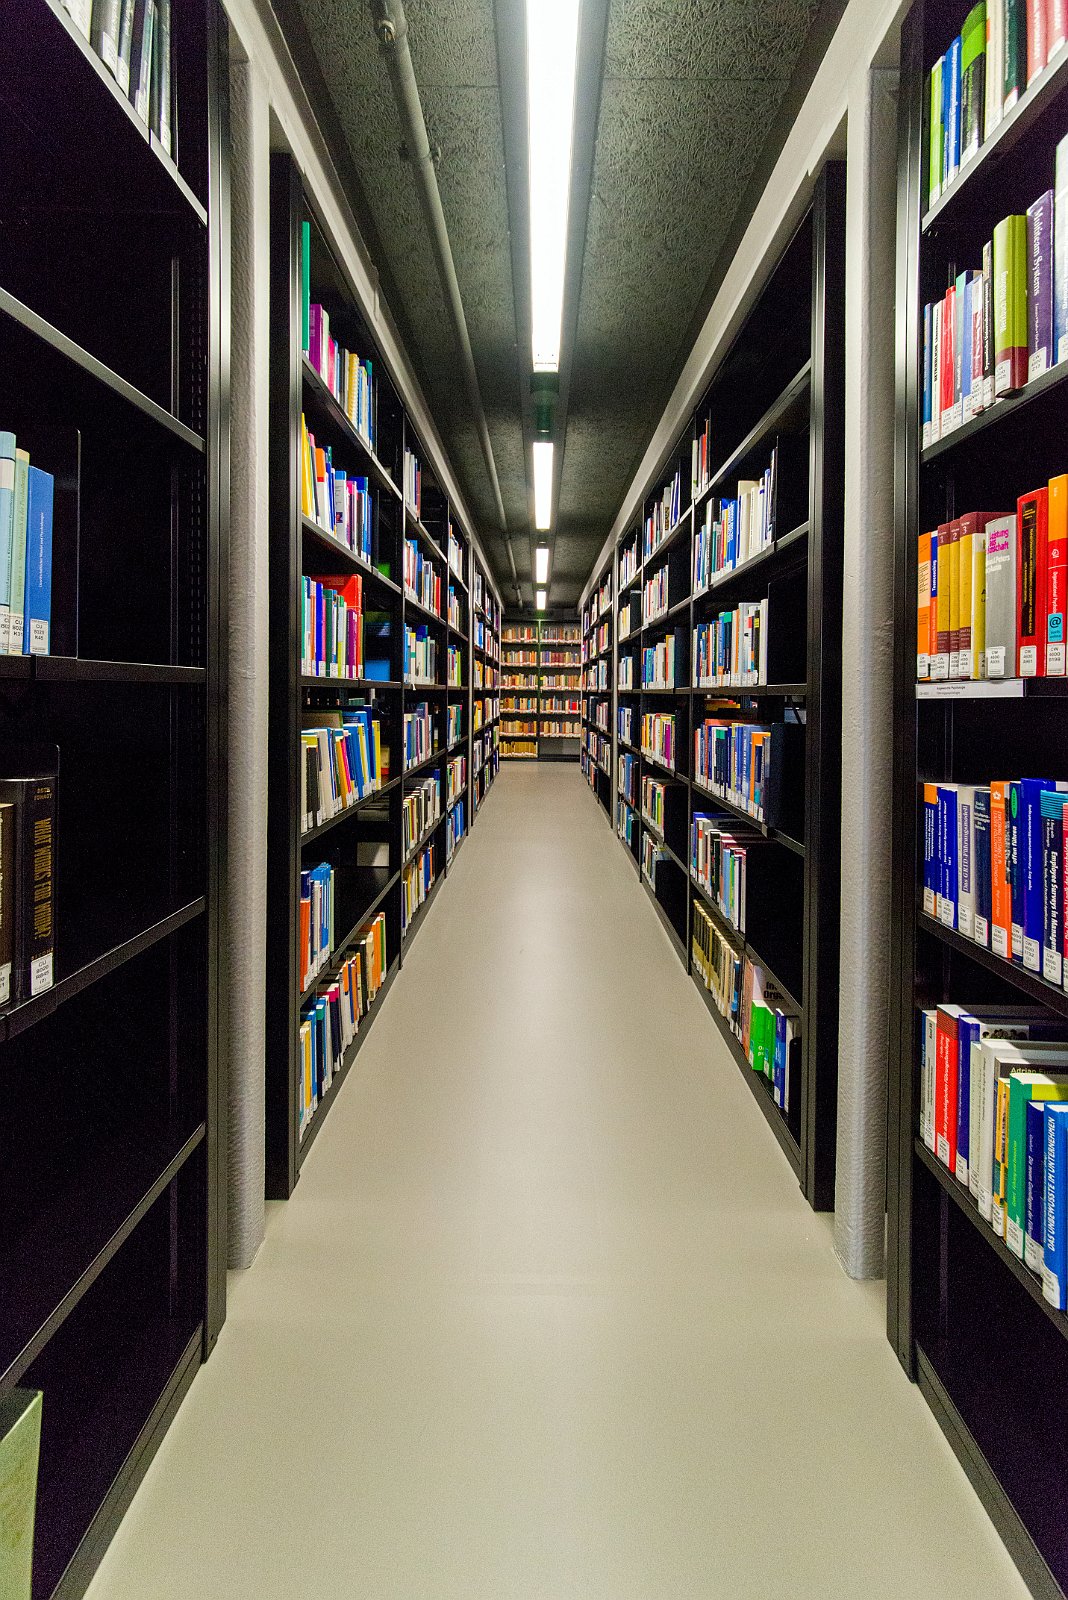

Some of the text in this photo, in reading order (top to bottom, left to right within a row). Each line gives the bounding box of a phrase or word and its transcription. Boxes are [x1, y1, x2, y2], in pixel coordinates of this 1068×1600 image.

[1033, 206, 1043, 255] Multiteam
[1032, 255, 1042, 297] Systems
[952, 533, 958, 541] 2
[962, 526, 968, 534] 3
[1051, 598, 1059, 614] Psycholo
[34, 817, 52, 846] WHAT
[34, 845, 52, 882] WORKS
[1050, 851, 1059, 883] Employee
[34, 880, 52, 902] FOR
[1050, 883, 1058, 910] Surveys
[1050, 918, 1058, 951] Managem
[1047, 1116, 1056, 1251] DAS UNBEWUSSTE IM UNTERNEHMEN
